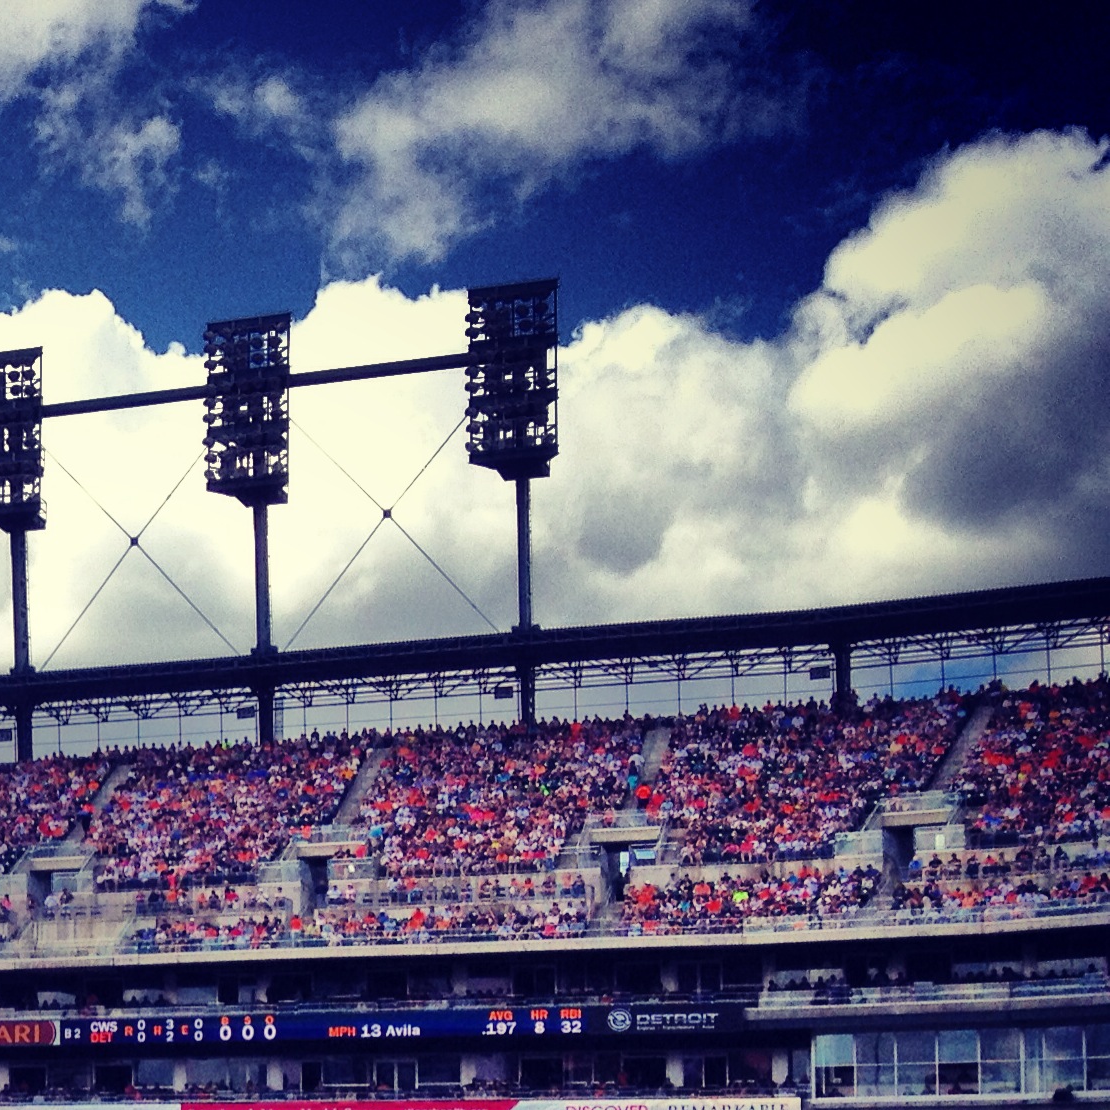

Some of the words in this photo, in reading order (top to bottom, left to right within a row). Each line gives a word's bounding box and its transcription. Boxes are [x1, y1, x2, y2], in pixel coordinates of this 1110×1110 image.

[489, 1011, 513, 1021] AVG
[531, 1010, 548, 1020] HR
[560, 1009, 582, 1019] RBI
[636, 1013, 719, 1025] DETROIT
[90, 1021, 118, 1033] CWS
[137, 1019, 146, 1031] 0
[166, 1019, 174, 1030] 3
[194, 1018, 203, 1030] 0
[124, 1026, 133, 1036] R
[153, 1025, 162, 1035] H
[328, 1026, 356, 1037] MPH
[361, 1024, 381, 1038] 13
[386, 1024, 421, 1037] Avila
[481, 1021, 517, 1035] .197
[534, 1020, 545, 1034] 8
[561, 1020, 582, 1034] 32
[64, 1028, 72, 1039] B
[74, 1028, 81, 1039] 2
[90, 1032, 114, 1043] DET
[137, 1031, 146, 1042] 0
[166, 1031, 174, 1042] 2
[194, 1030, 203, 1041] 0
[219, 1025, 232, 1041] 0
[242, 1024, 254, 1040] 0
[263, 1024, 276, 1040] 0
